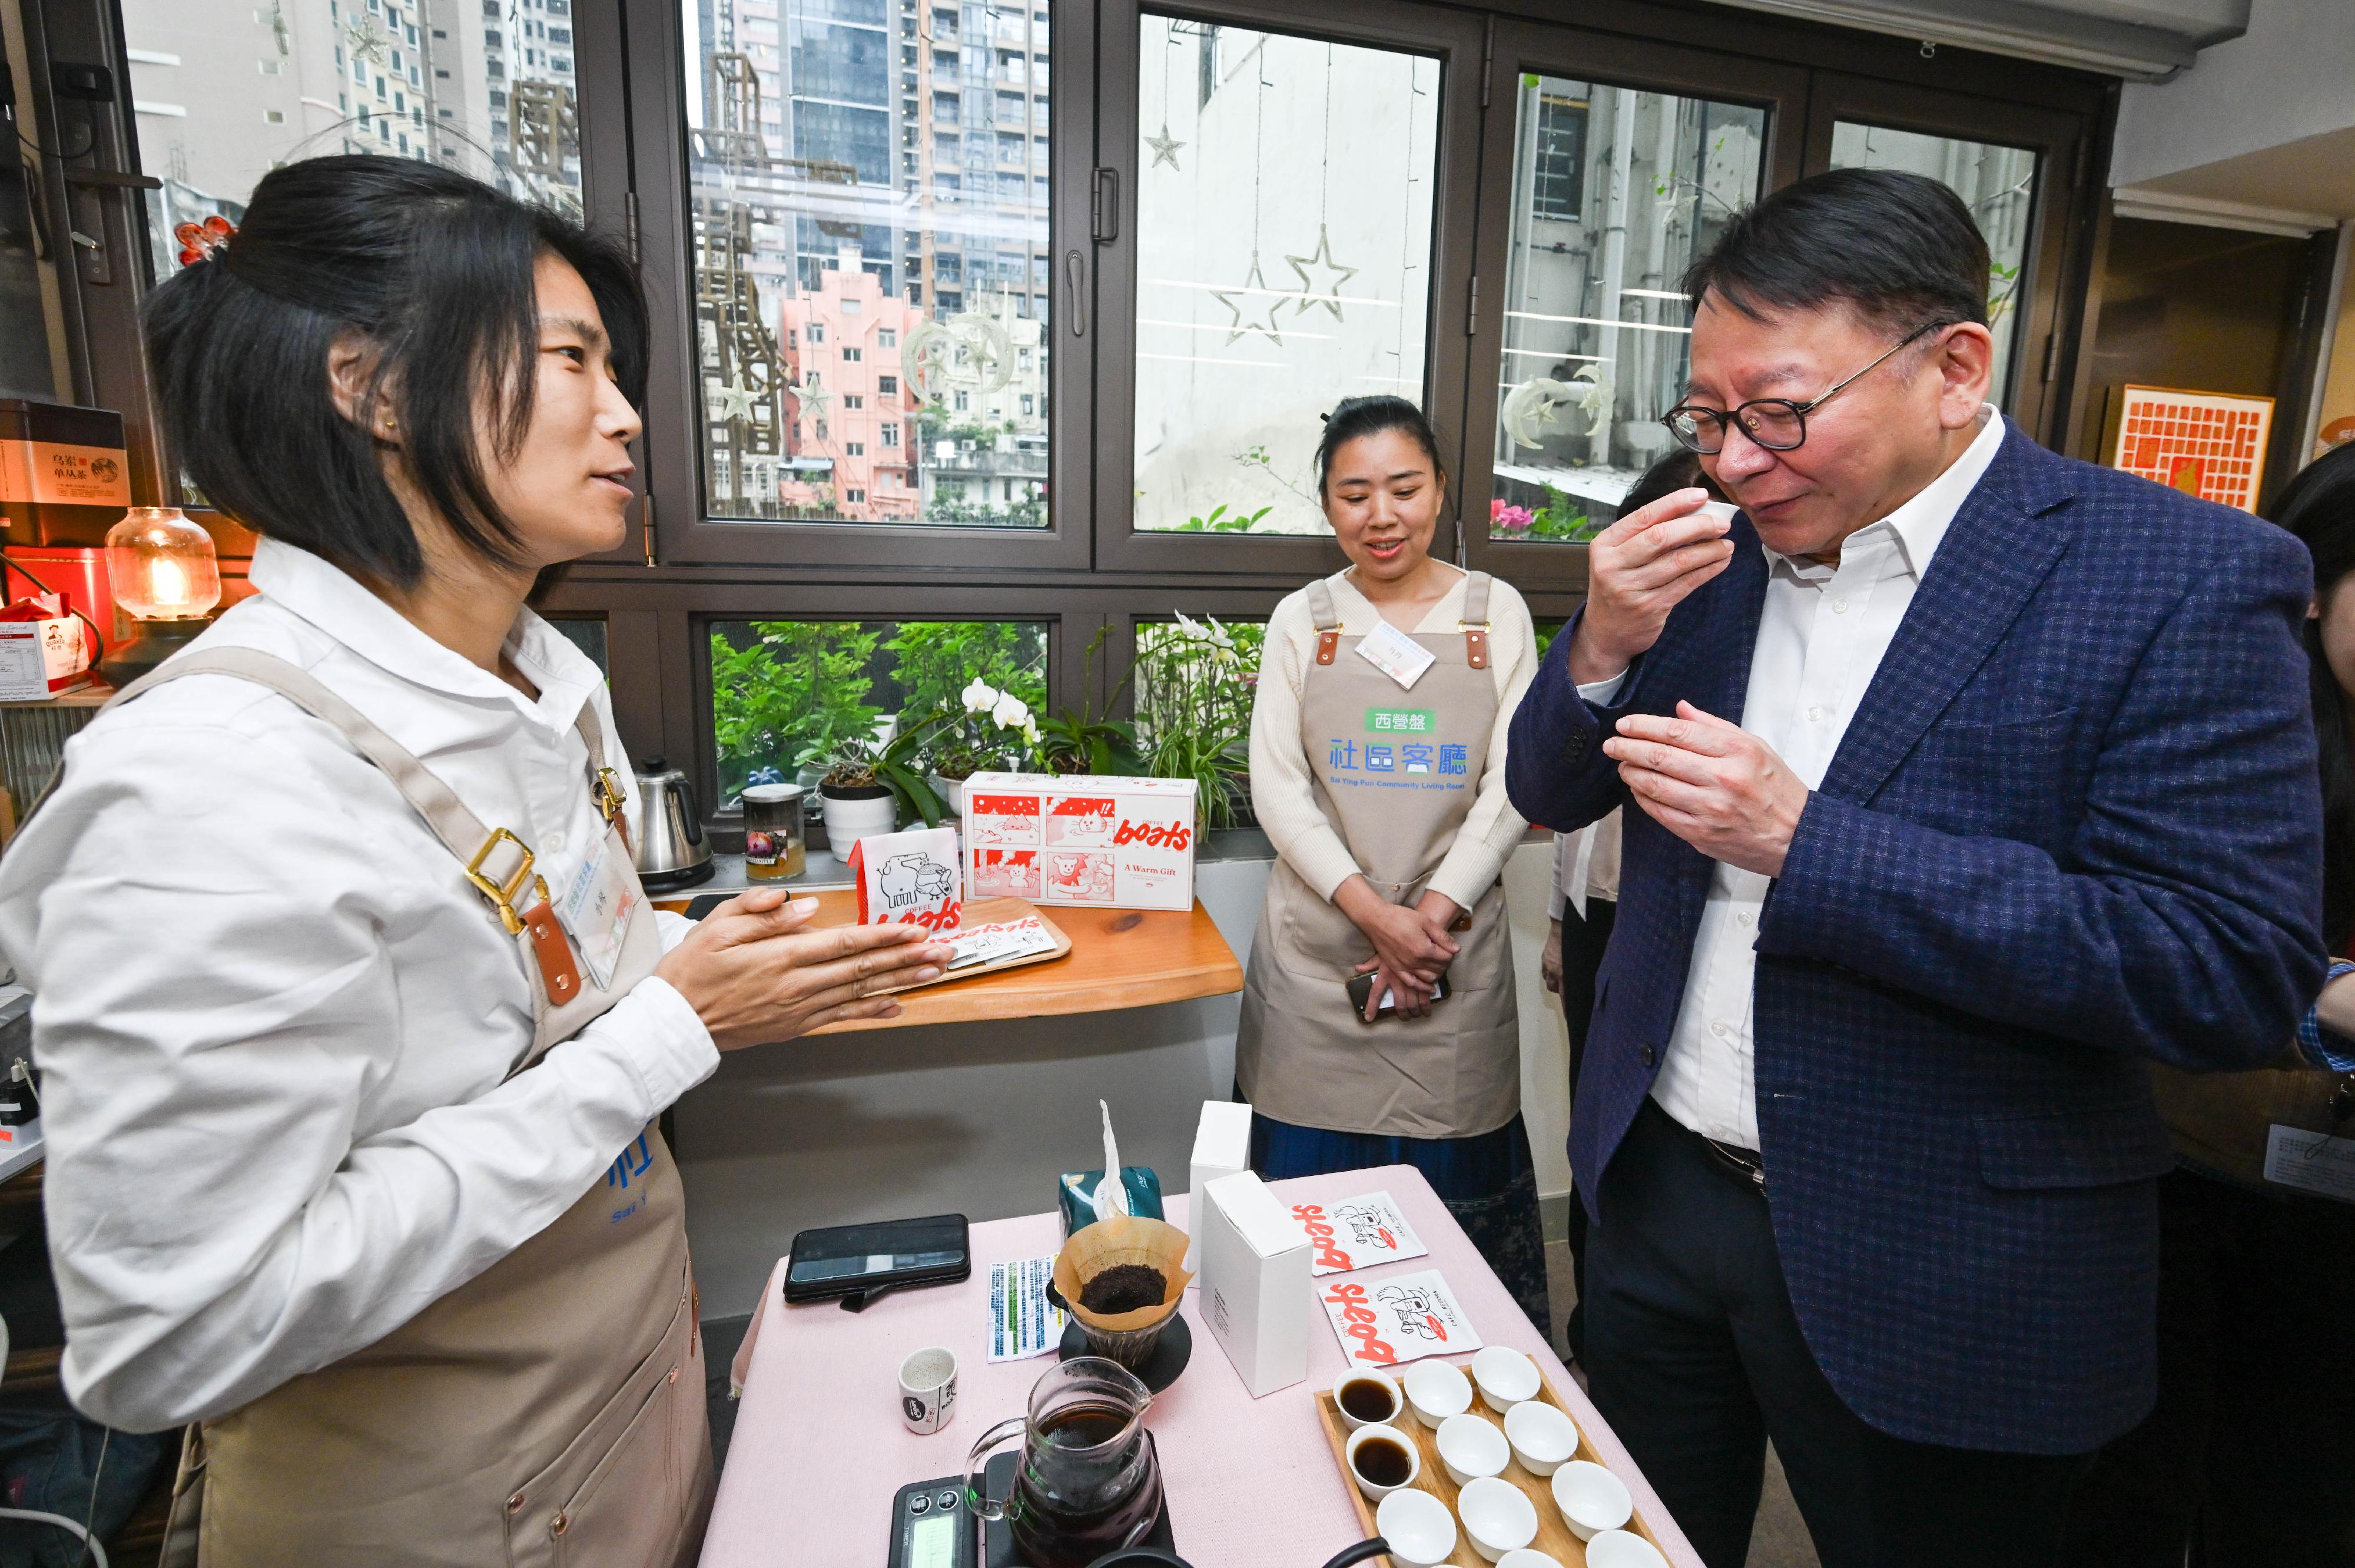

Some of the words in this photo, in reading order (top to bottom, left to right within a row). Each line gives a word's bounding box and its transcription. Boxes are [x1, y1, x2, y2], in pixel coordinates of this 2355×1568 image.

[45, 639, 65, 648] QUAKER
[1374, 713, 1426, 731] 西營盤
[1329, 739, 1468, 775] 社區客廳
[1342, 778, 1358, 787] Ying
[1376, 781, 1419, 790] Community
[1421, 783, 1444, 791] Living
[1113, 818, 1192, 851] boats
[1133, 865, 1158, 874] Warm
[1160, 867, 1176, 876] Gift
[904, 904, 932, 914] COFFEE
[1325, 1284, 1398, 1364] boats
[1335, 1313, 1351, 1337] COFFEE
